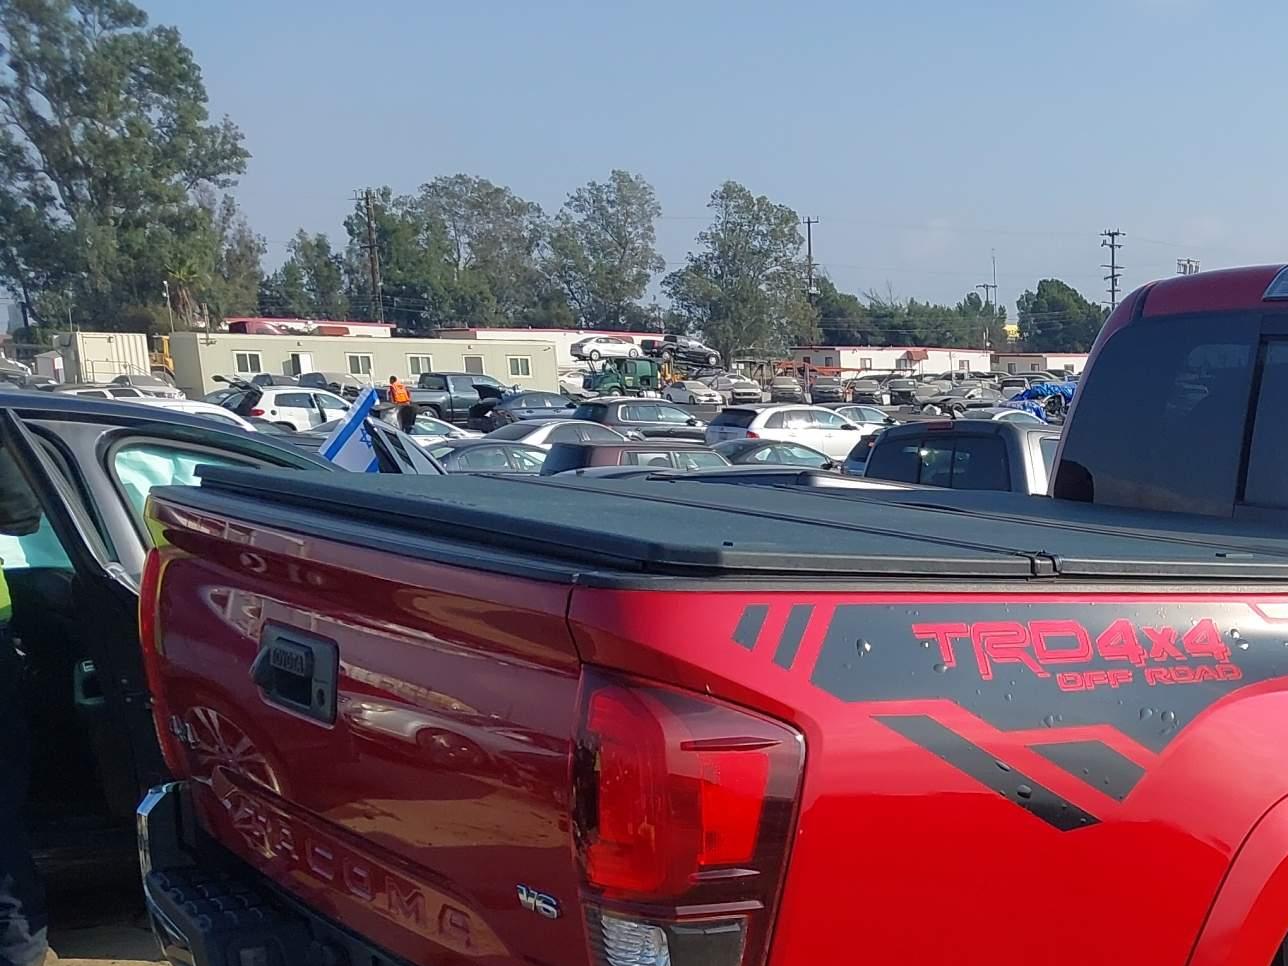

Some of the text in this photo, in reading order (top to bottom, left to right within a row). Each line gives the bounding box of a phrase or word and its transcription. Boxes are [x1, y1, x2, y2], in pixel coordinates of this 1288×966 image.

[1056, 664, 1243, 692] OFF ROAD
[516, 883, 558, 920] V6
